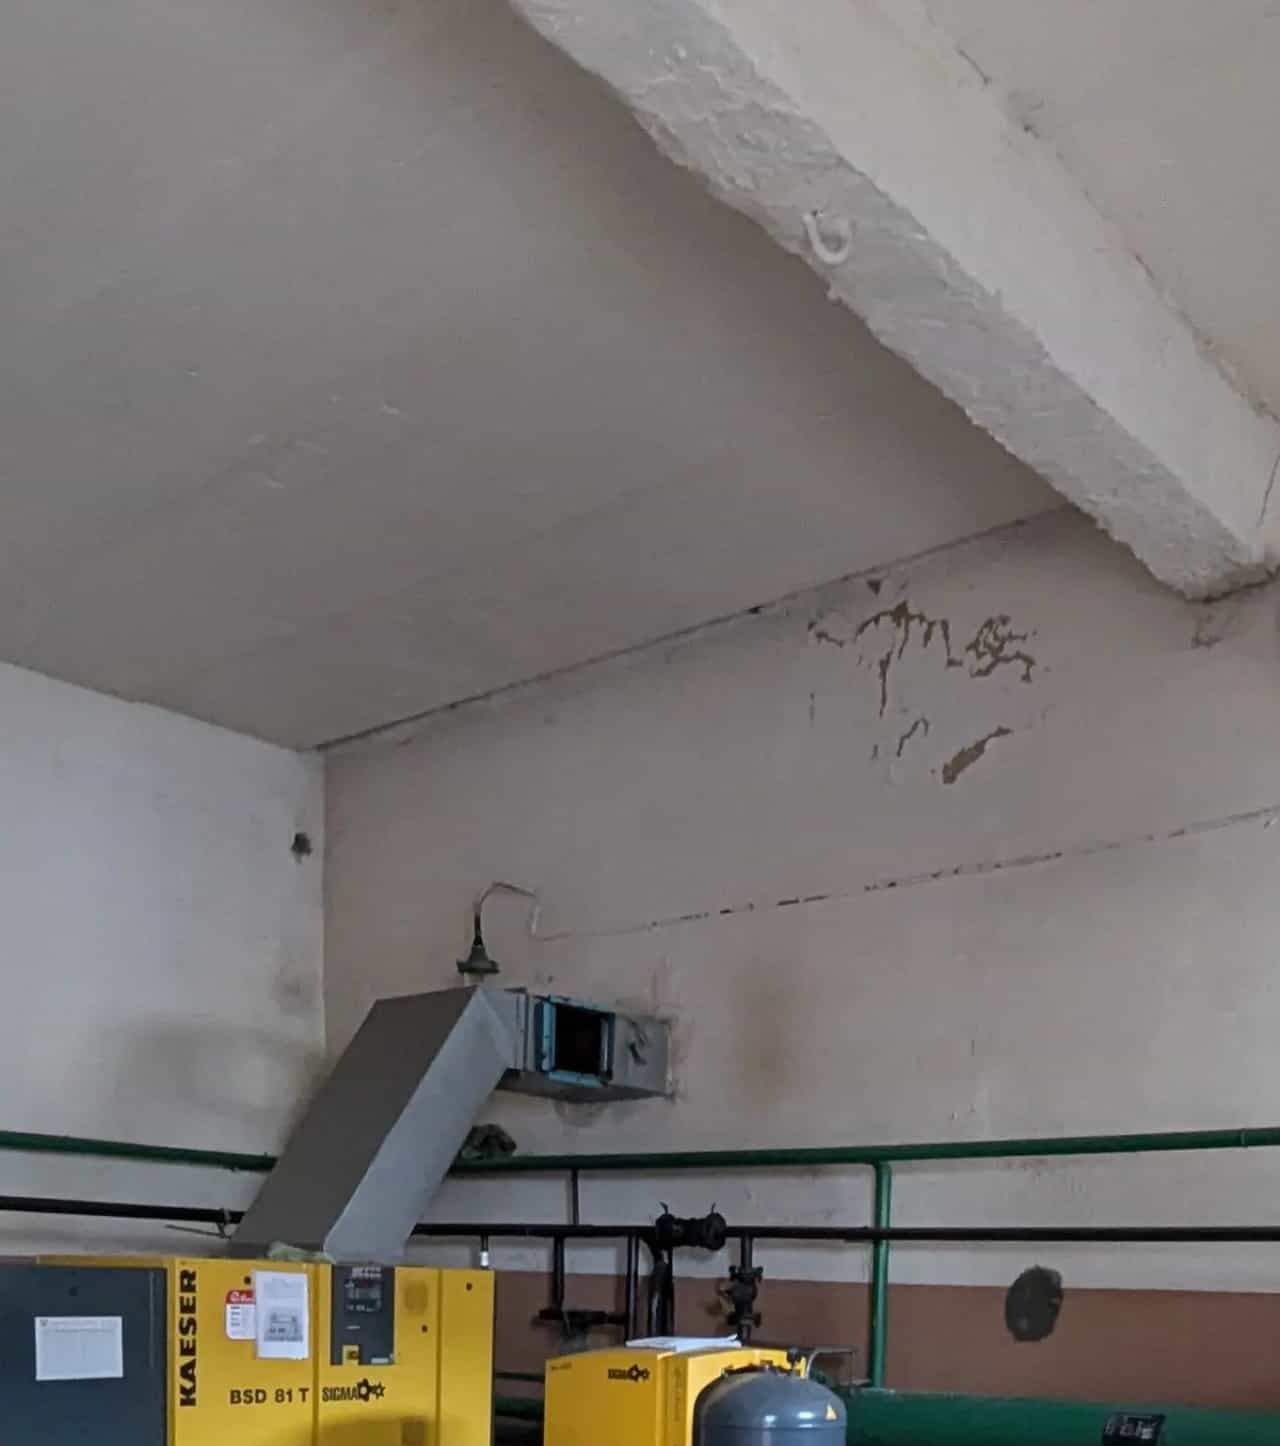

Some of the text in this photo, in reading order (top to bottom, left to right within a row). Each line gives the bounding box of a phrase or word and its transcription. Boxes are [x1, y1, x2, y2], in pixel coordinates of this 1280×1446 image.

[179, 1269, 197, 1407] KAESER
[230, 1387, 310, 1404] BSD 81 T
